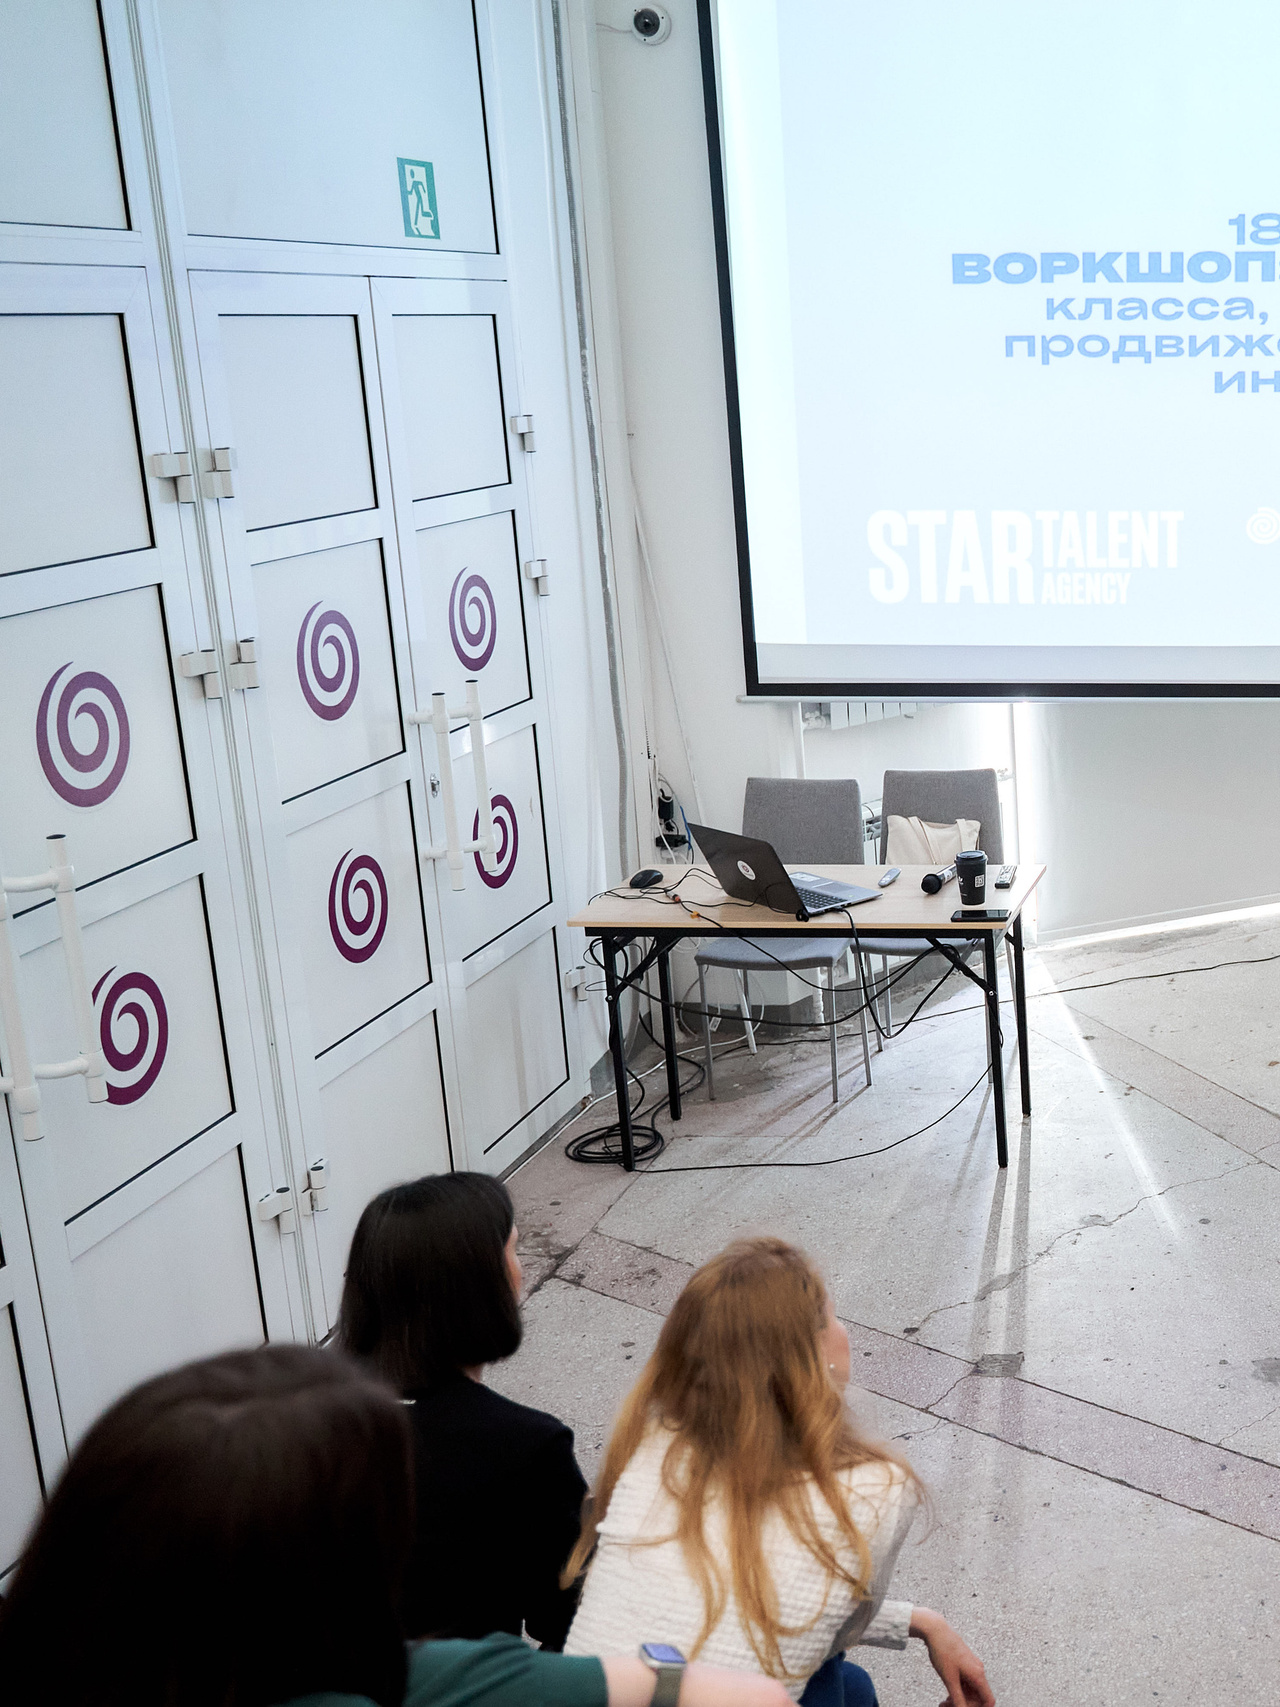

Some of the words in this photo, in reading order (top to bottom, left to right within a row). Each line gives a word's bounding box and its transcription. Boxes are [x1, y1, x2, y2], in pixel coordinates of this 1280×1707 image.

[1046, 296, 1269, 325] класса,
[867, 509, 1034, 605] STAR
[1035, 510, 1185, 569] TALENT
[1041, 572, 1132, 605] AGENCY
